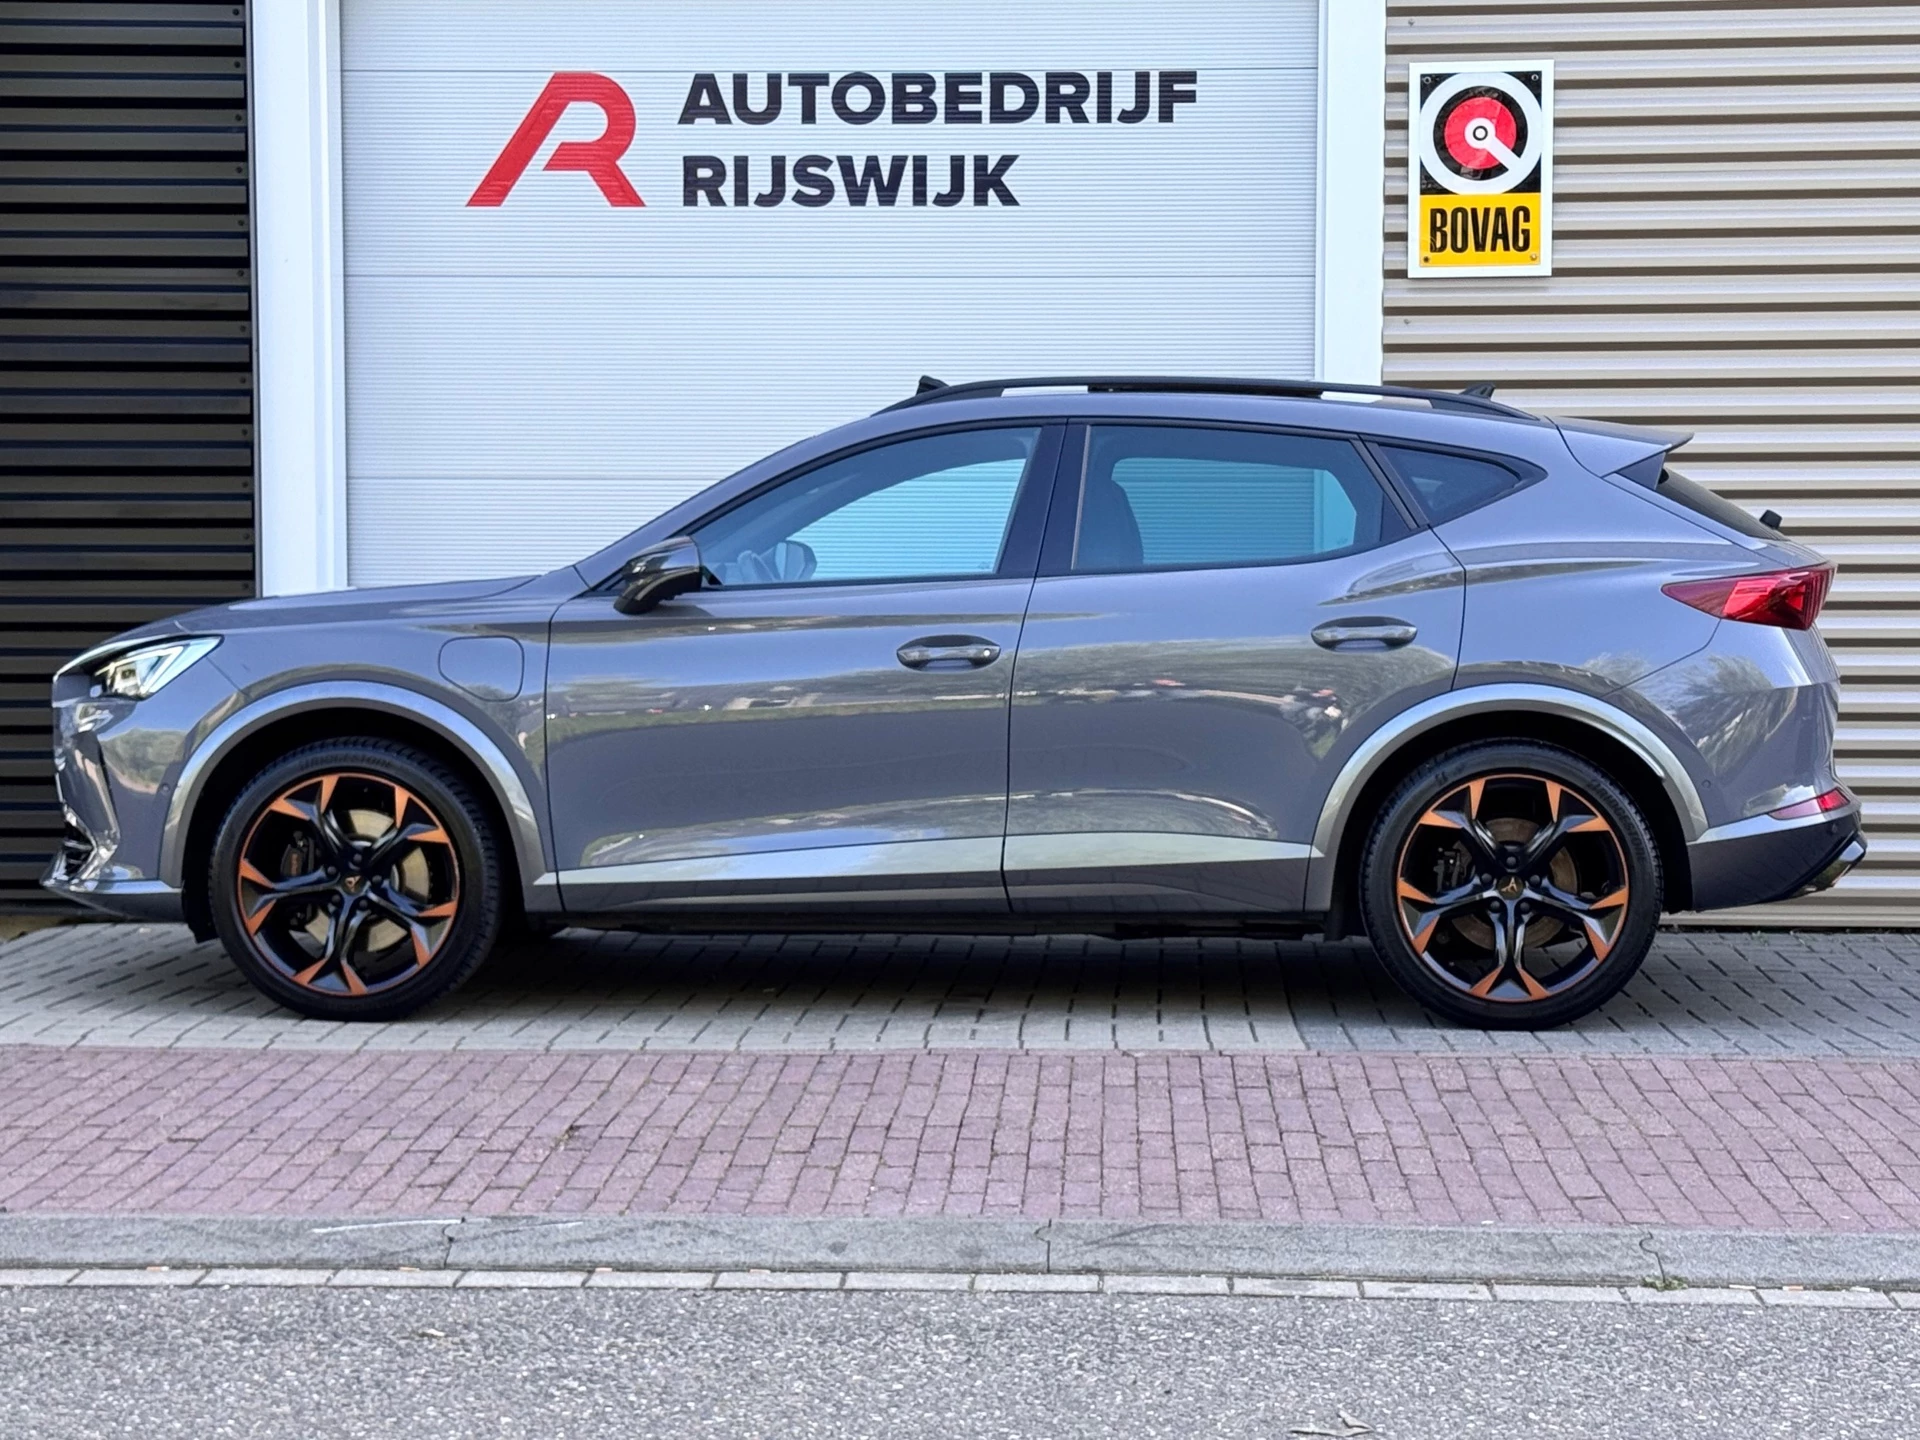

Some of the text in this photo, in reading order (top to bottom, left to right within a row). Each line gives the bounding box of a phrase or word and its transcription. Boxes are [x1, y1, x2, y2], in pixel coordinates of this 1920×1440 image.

[678, 71, 1197, 125] AUTOBEDRIJF
[683, 155, 1019, 207] RIJSWIJK
[1430, 206, 1530, 253] BOVAG
